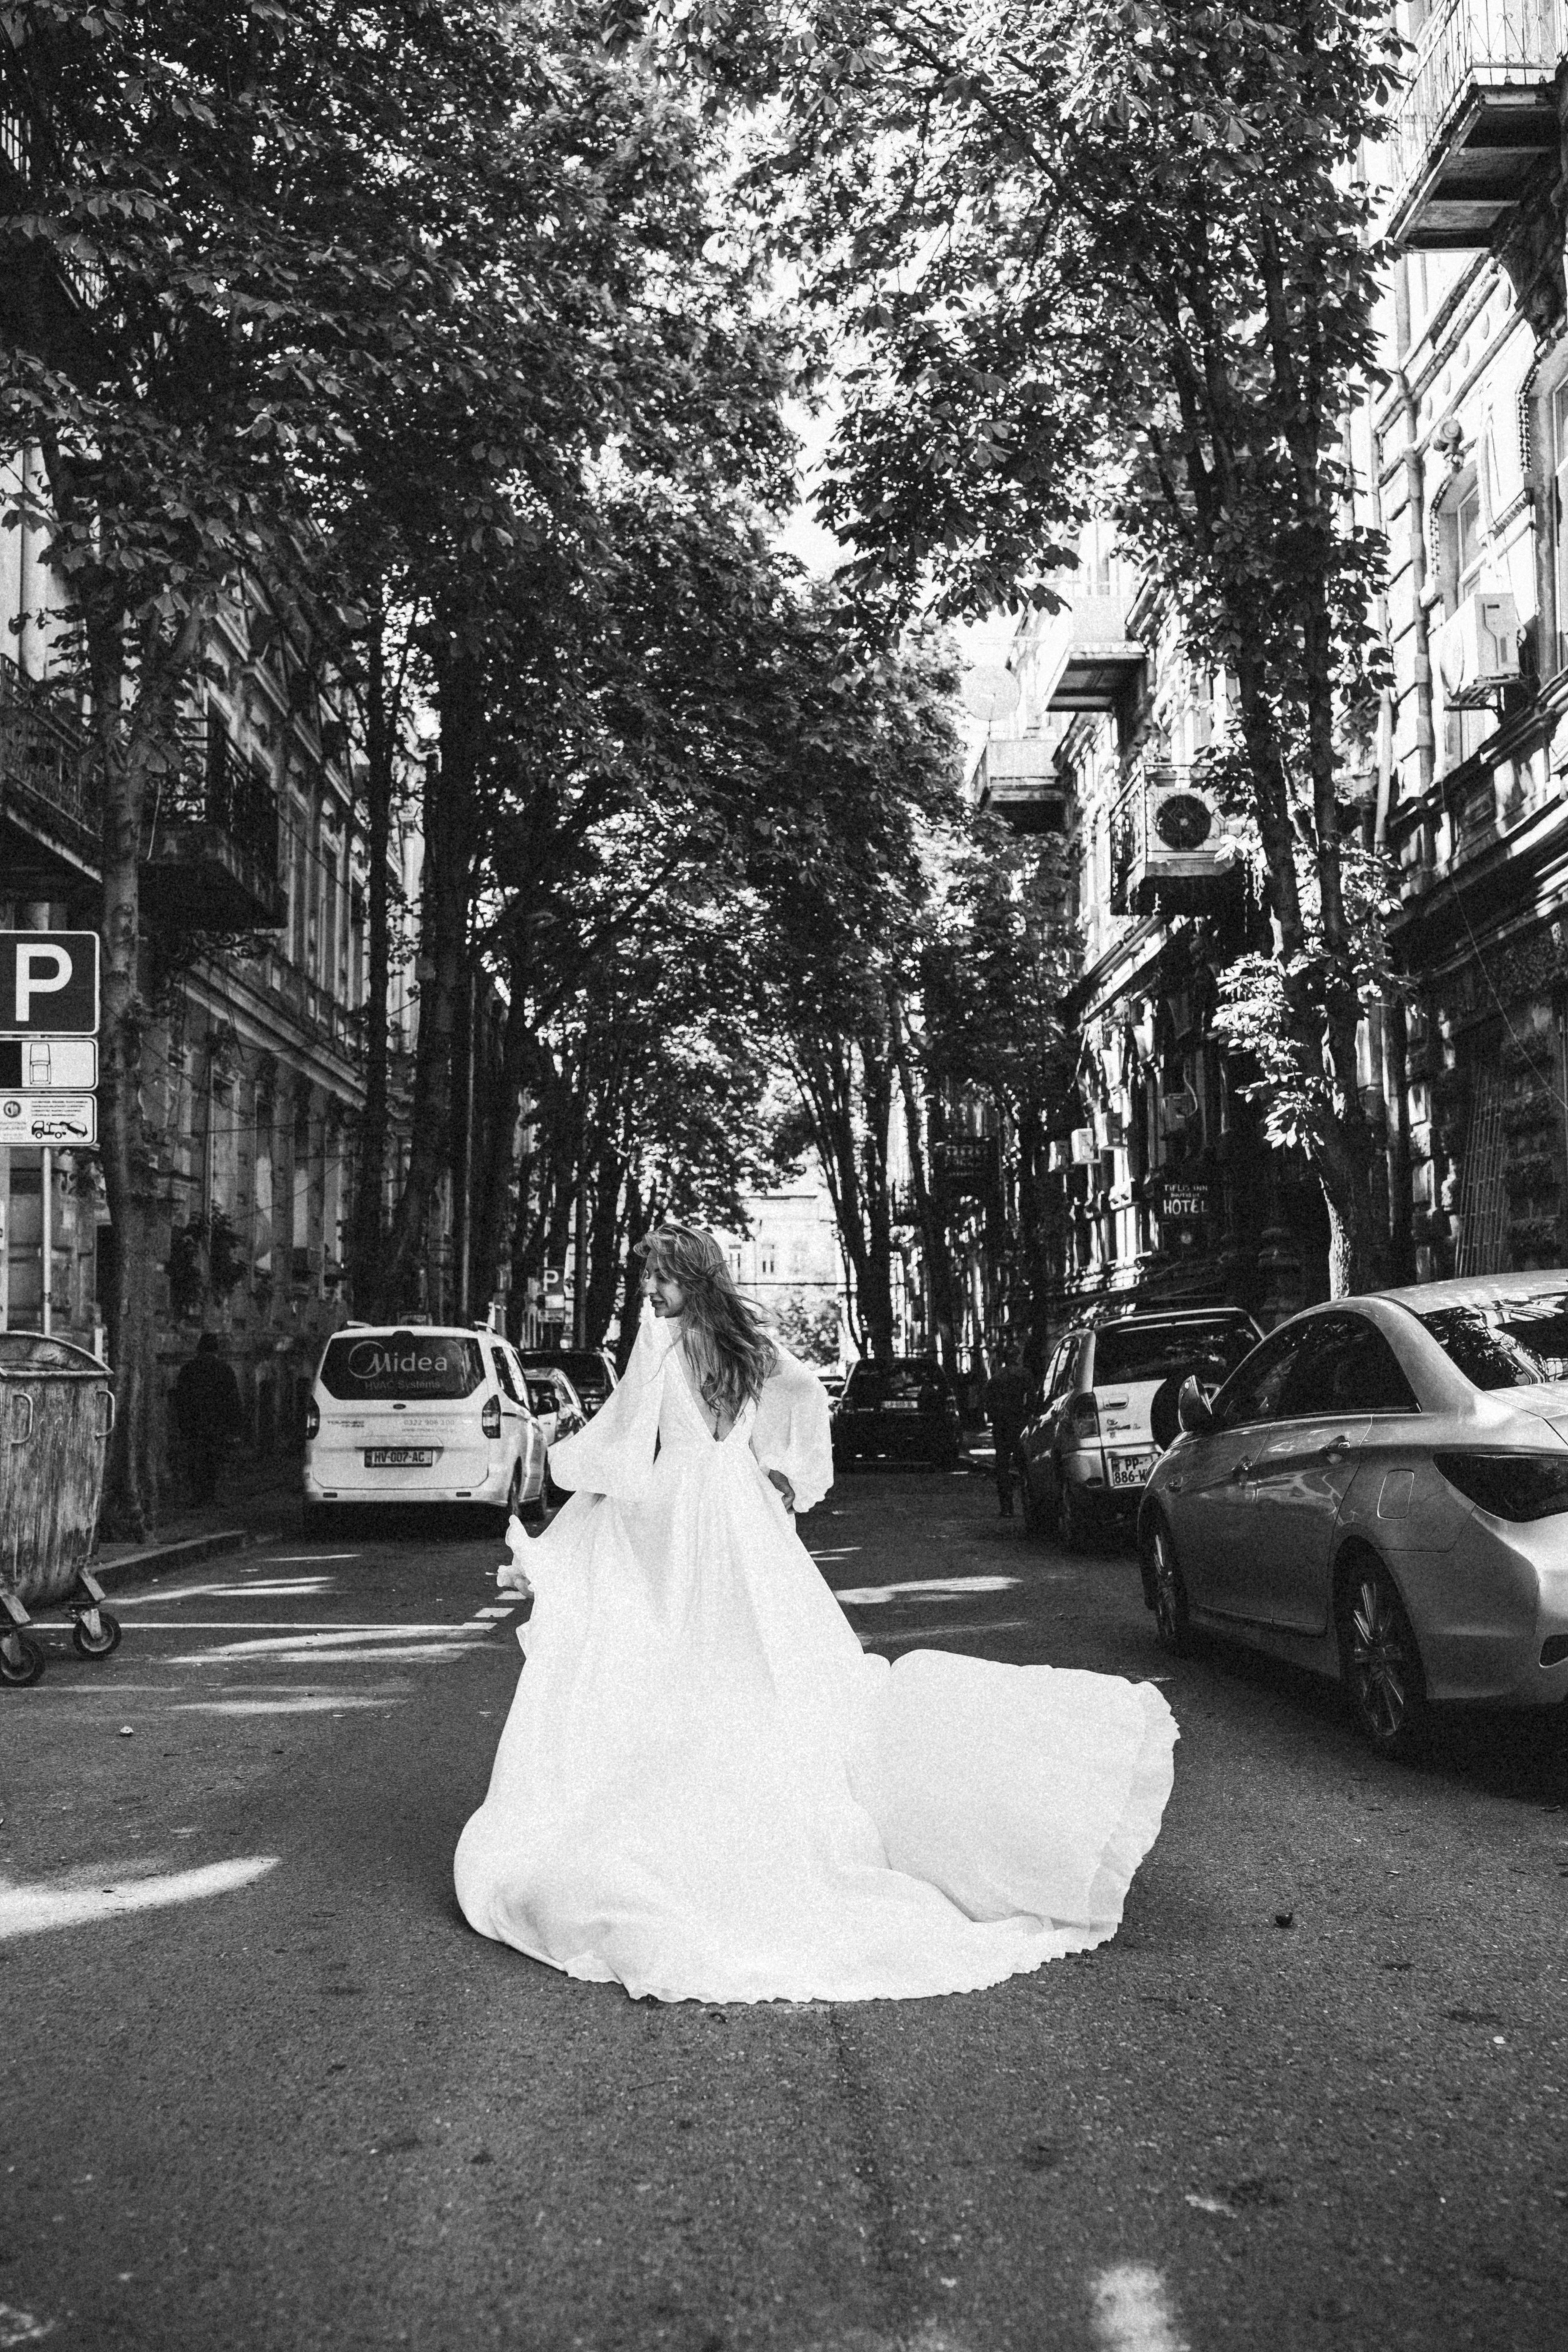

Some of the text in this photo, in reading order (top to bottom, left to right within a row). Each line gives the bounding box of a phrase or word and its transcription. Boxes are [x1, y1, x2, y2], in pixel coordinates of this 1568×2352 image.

[16, 943, 73, 1022] P
[1164, 1199, 1208, 1215] HOTEL
[543, 1270, 559, 1292] P
[353, 1346, 448, 1376] Midea
[374, 1452, 424, 1463] HV-007-AC
